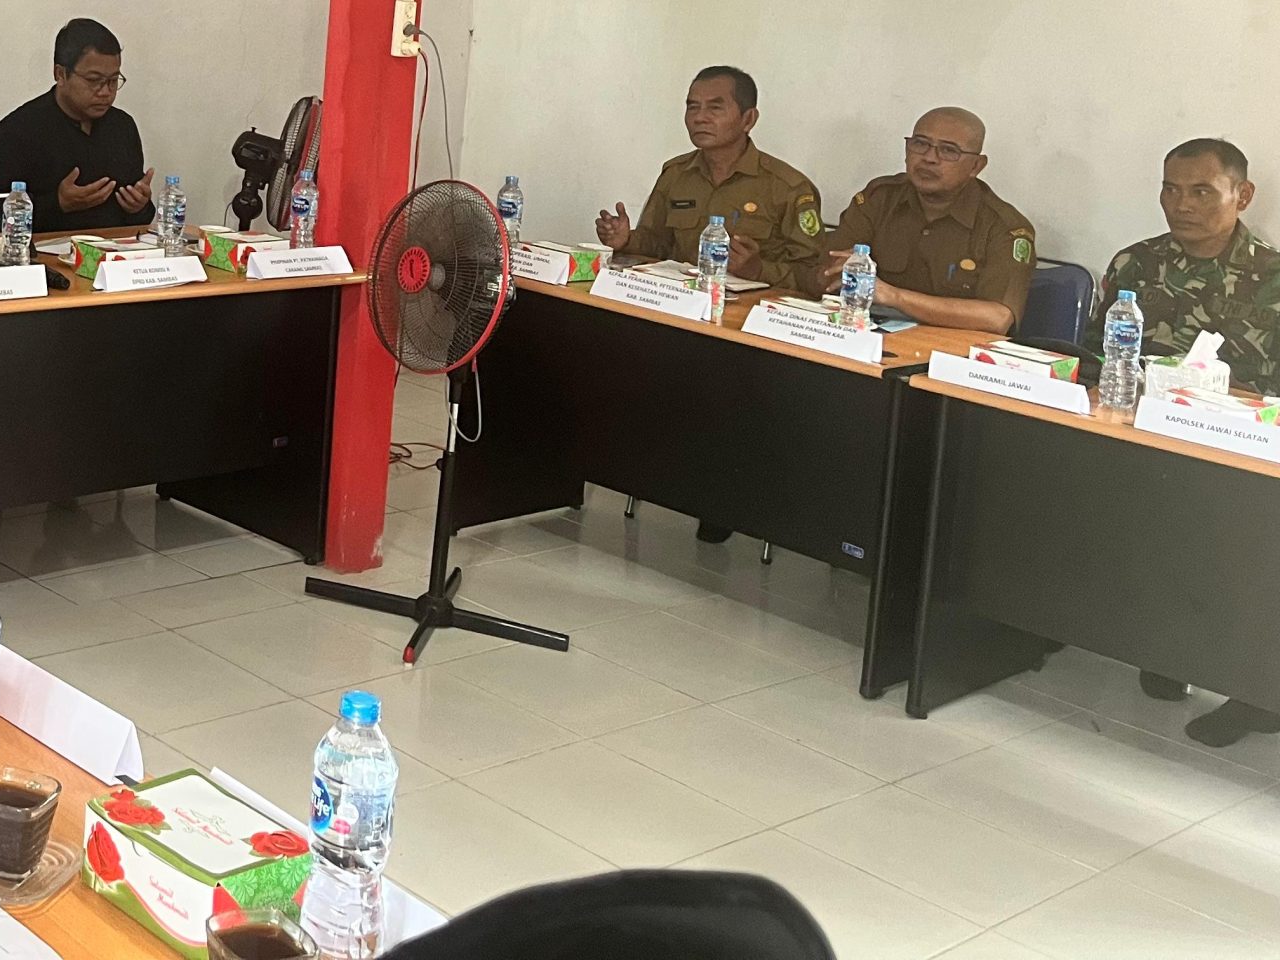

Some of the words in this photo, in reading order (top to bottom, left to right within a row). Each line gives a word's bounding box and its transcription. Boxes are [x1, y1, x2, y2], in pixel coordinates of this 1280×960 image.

[608, 270, 628, 279] KEPALA
[615, 280, 627, 288] DAN
[628, 284, 658, 295] KESEHATAN
[789, 312, 808, 322] DINAS
[968, 371, 1006, 386] DANRAMIL
[1008, 381, 1032, 391] JAWAI
[1165, 414, 1205, 430] KAPOLSEK
[1206, 424, 1232, 436] JAWAI
[1233, 430, 1269, 444] SELATAN
